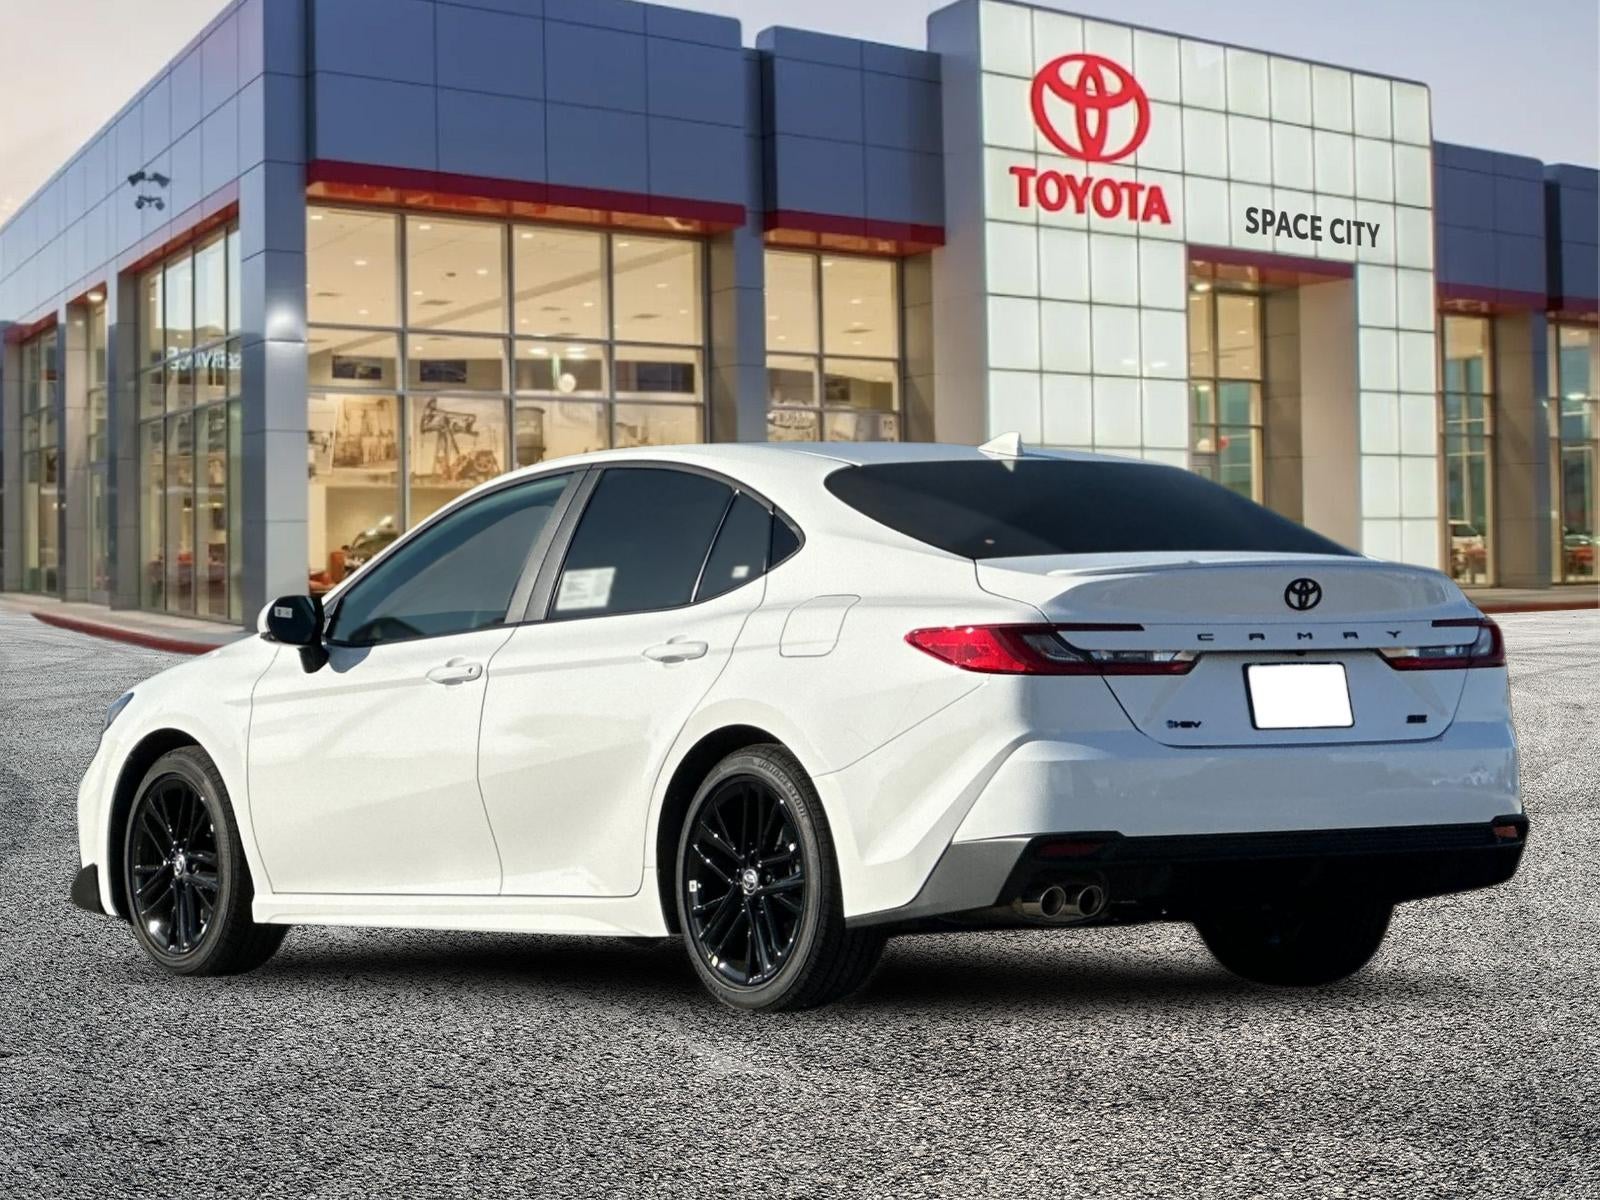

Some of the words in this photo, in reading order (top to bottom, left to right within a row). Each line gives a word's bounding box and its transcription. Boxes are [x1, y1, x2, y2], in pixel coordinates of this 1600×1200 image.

[1009, 166, 1171, 225] TOYOTA
[1245, 206, 1322, 242] SPACE
[1329, 218, 1381, 248] CITY
[1197, 630, 1401, 641] CAMRY
